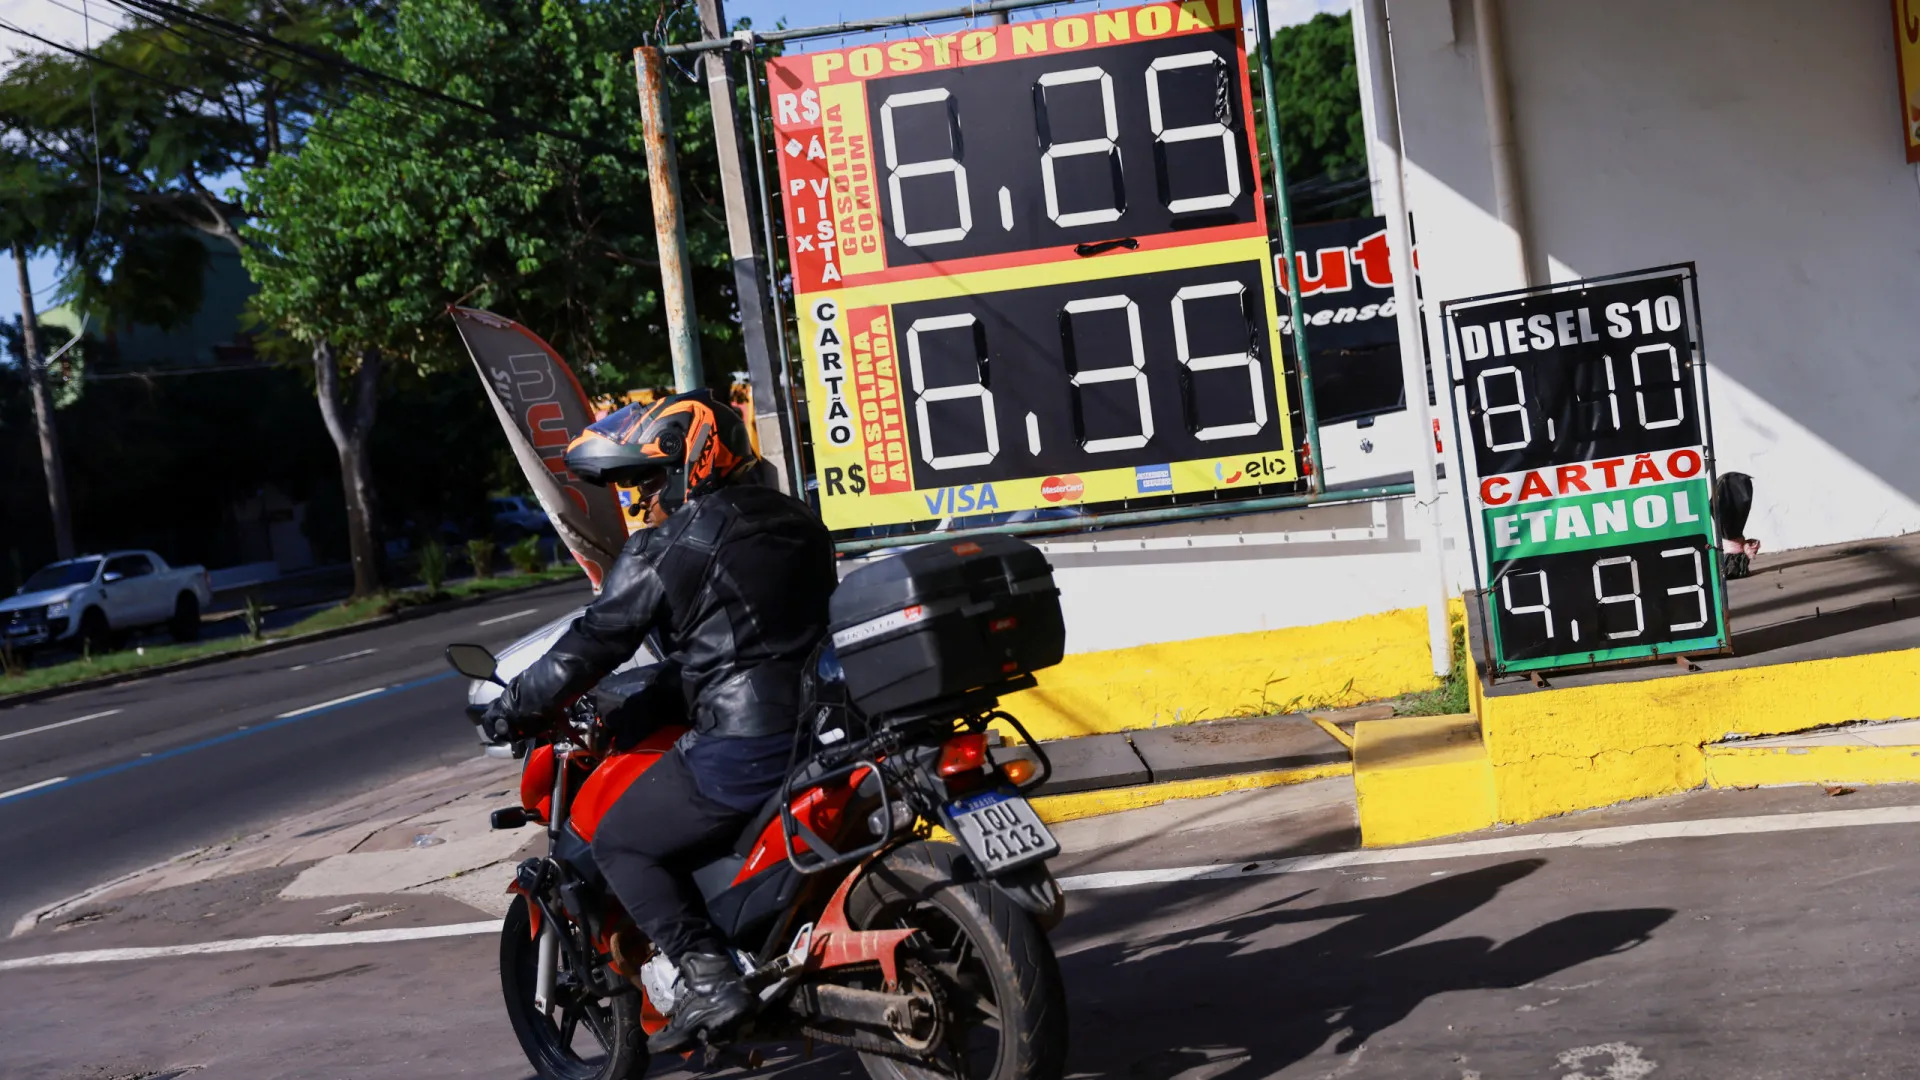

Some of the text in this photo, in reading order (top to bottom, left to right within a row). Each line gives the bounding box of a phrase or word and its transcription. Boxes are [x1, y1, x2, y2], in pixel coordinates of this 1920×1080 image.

[812, 0, 1236, 83] POSTO NONOAI
[777, 88, 820, 125] R$
[807, 135, 841, 283] Á VISTA
[826, 104, 858, 256] GASOLINA
[849, 135, 877, 254] COMUM
[790, 178, 815, 253] PIX
[1460, 295, 1682, 361] DIESEL S10
[816, 303, 850, 443] CARTÃO
[853, 331, 888, 484] GASOLINA
[870, 315, 907, 482] ADITIVADA
[824, 462, 866, 497] R$
[924, 483, 998, 515] VISA
[1245, 457, 1286, 477] elo
[1480, 453, 1701, 506] CARTÃO
[1494, 490, 1699, 548] ETANOL
[971, 802, 1022, 836] IQU
